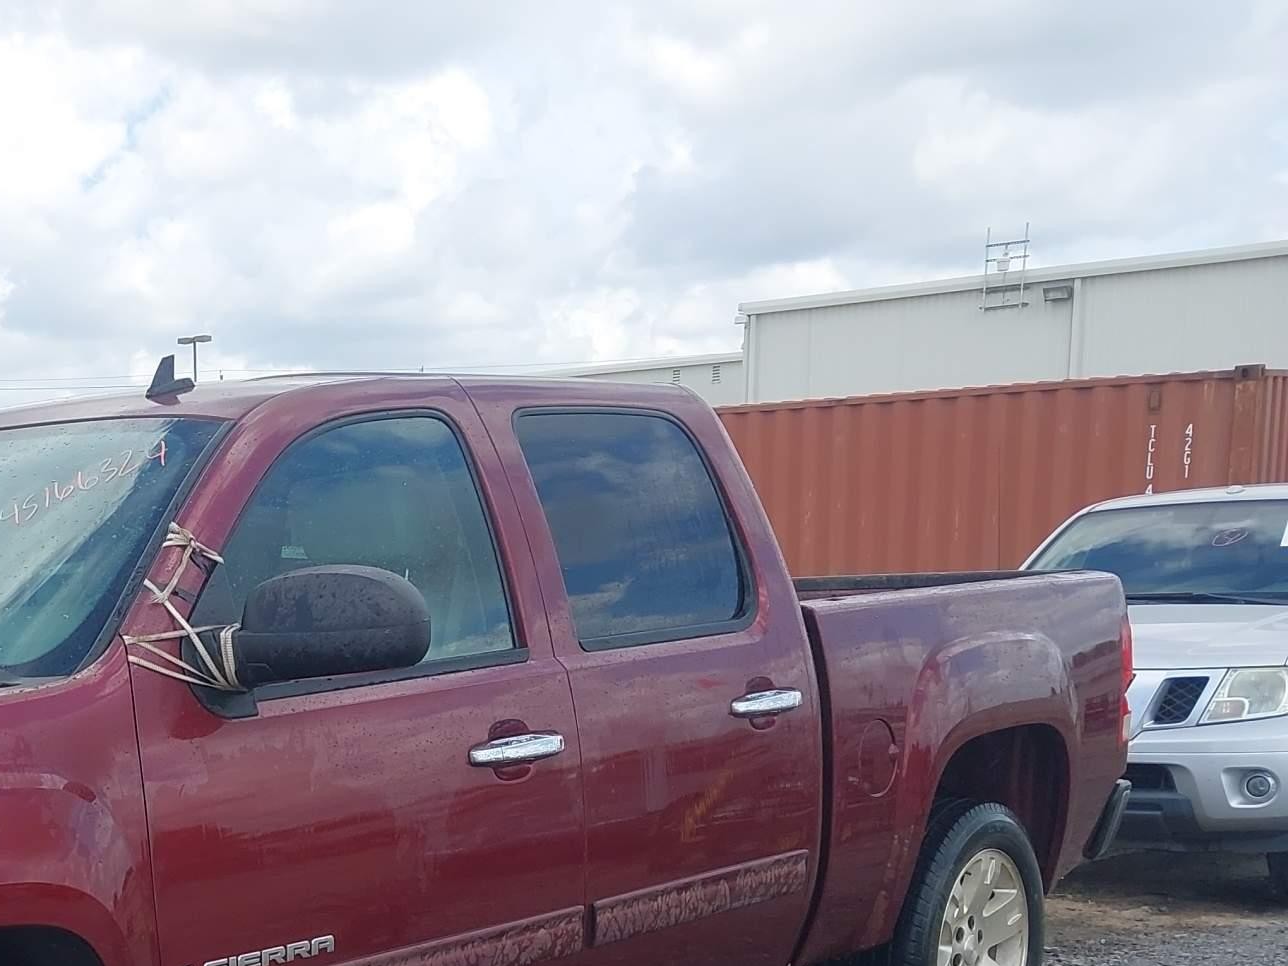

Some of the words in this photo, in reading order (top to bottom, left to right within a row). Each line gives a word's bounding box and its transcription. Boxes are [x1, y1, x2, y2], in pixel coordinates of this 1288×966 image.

[1145, 424, 1157, 479] TCLU
[1183, 423, 1193, 479] 42G1
[0, 440, 168, 524] 45166324
